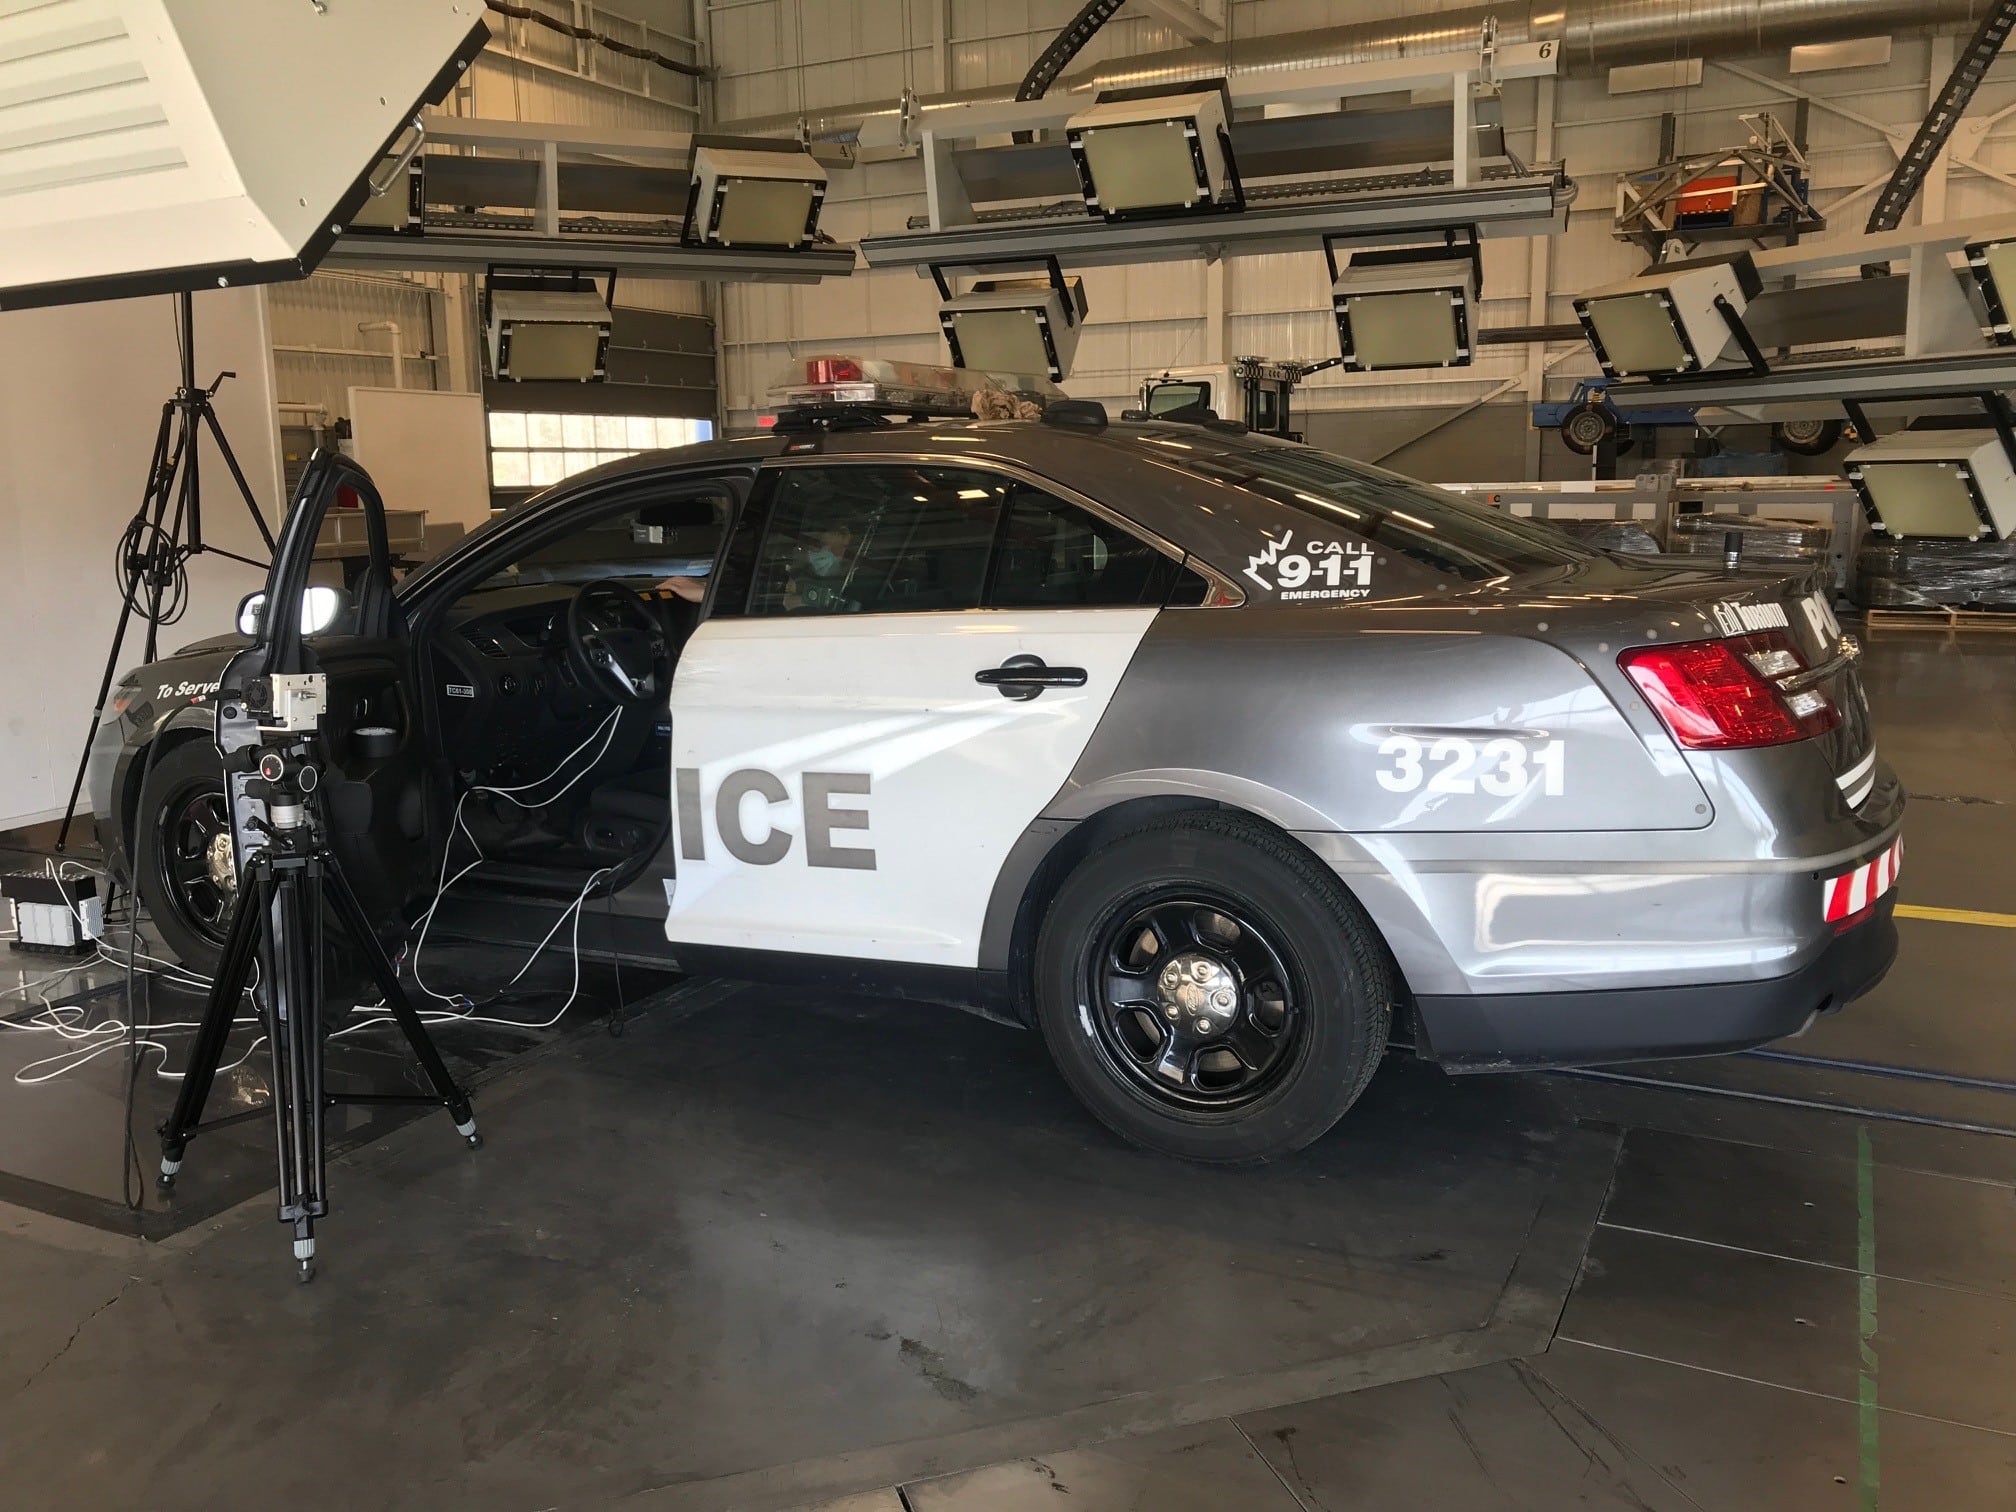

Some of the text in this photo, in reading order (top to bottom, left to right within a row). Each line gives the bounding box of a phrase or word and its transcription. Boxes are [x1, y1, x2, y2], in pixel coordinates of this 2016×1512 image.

[1539, 42, 1552, 59] 6
[839, 144, 849, 158] 4
[1306, 540, 1375, 555] CALL
[1277, 554, 1372, 588] 9-1-1
[1280, 589, 1371, 600] EMERGENCY
[156, 680, 220, 700] To Serve
[1375, 736, 1565, 797] 3231
[676, 768, 877, 870] ICE
